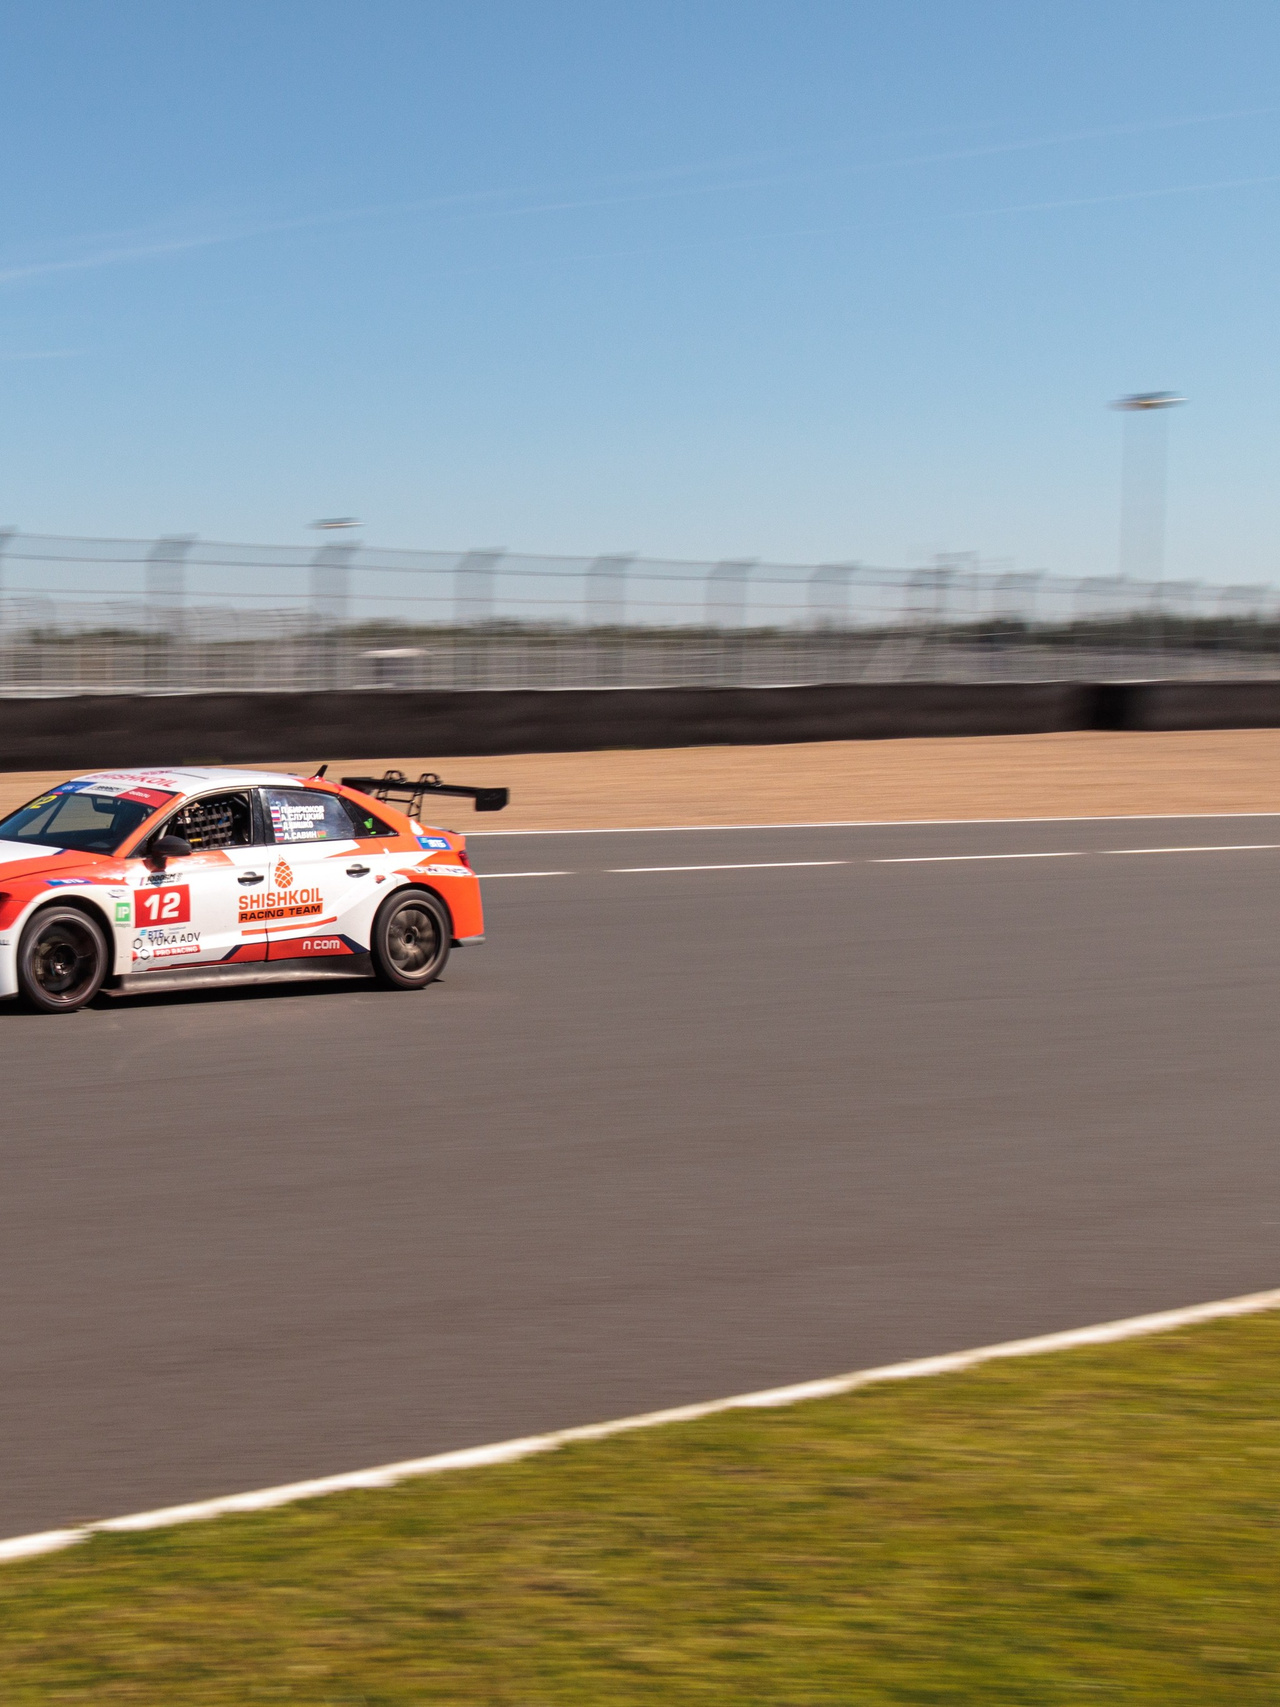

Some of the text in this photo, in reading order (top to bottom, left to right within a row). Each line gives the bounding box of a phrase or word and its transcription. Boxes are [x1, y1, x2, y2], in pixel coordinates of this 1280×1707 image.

[284, 831, 317, 840] А.САВИН
[144, 892, 181, 920] 12
[238, 887, 324, 911] SHISHKOIL
[240, 905, 321, 921] RACING TEAM
[180, 932, 201, 944] ADV
[155, 946, 199, 956] PRO RACING
